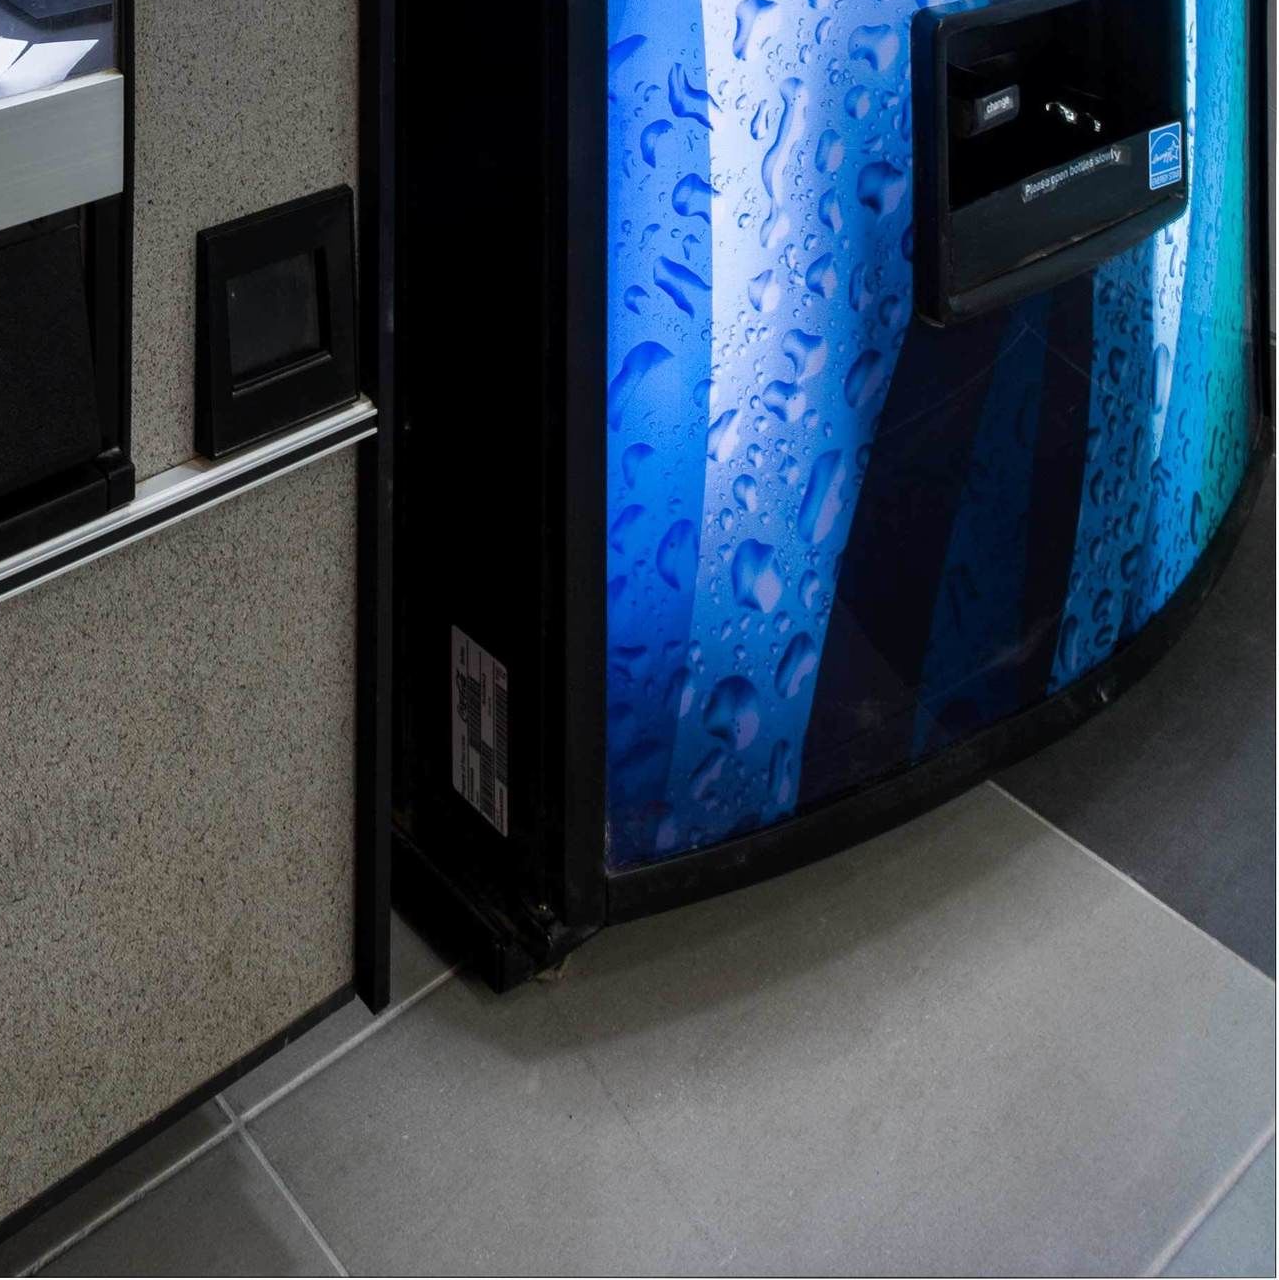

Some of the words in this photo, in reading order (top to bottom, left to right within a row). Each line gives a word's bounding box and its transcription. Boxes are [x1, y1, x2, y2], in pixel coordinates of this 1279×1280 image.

[985, 95, 1011, 115] change
[1024, 176, 1050, 197] Please
[1050, 170, 1070, 190] open
[1069, 157, 1095, 178] bottles
[1093, 147, 1122, 168] slowly
